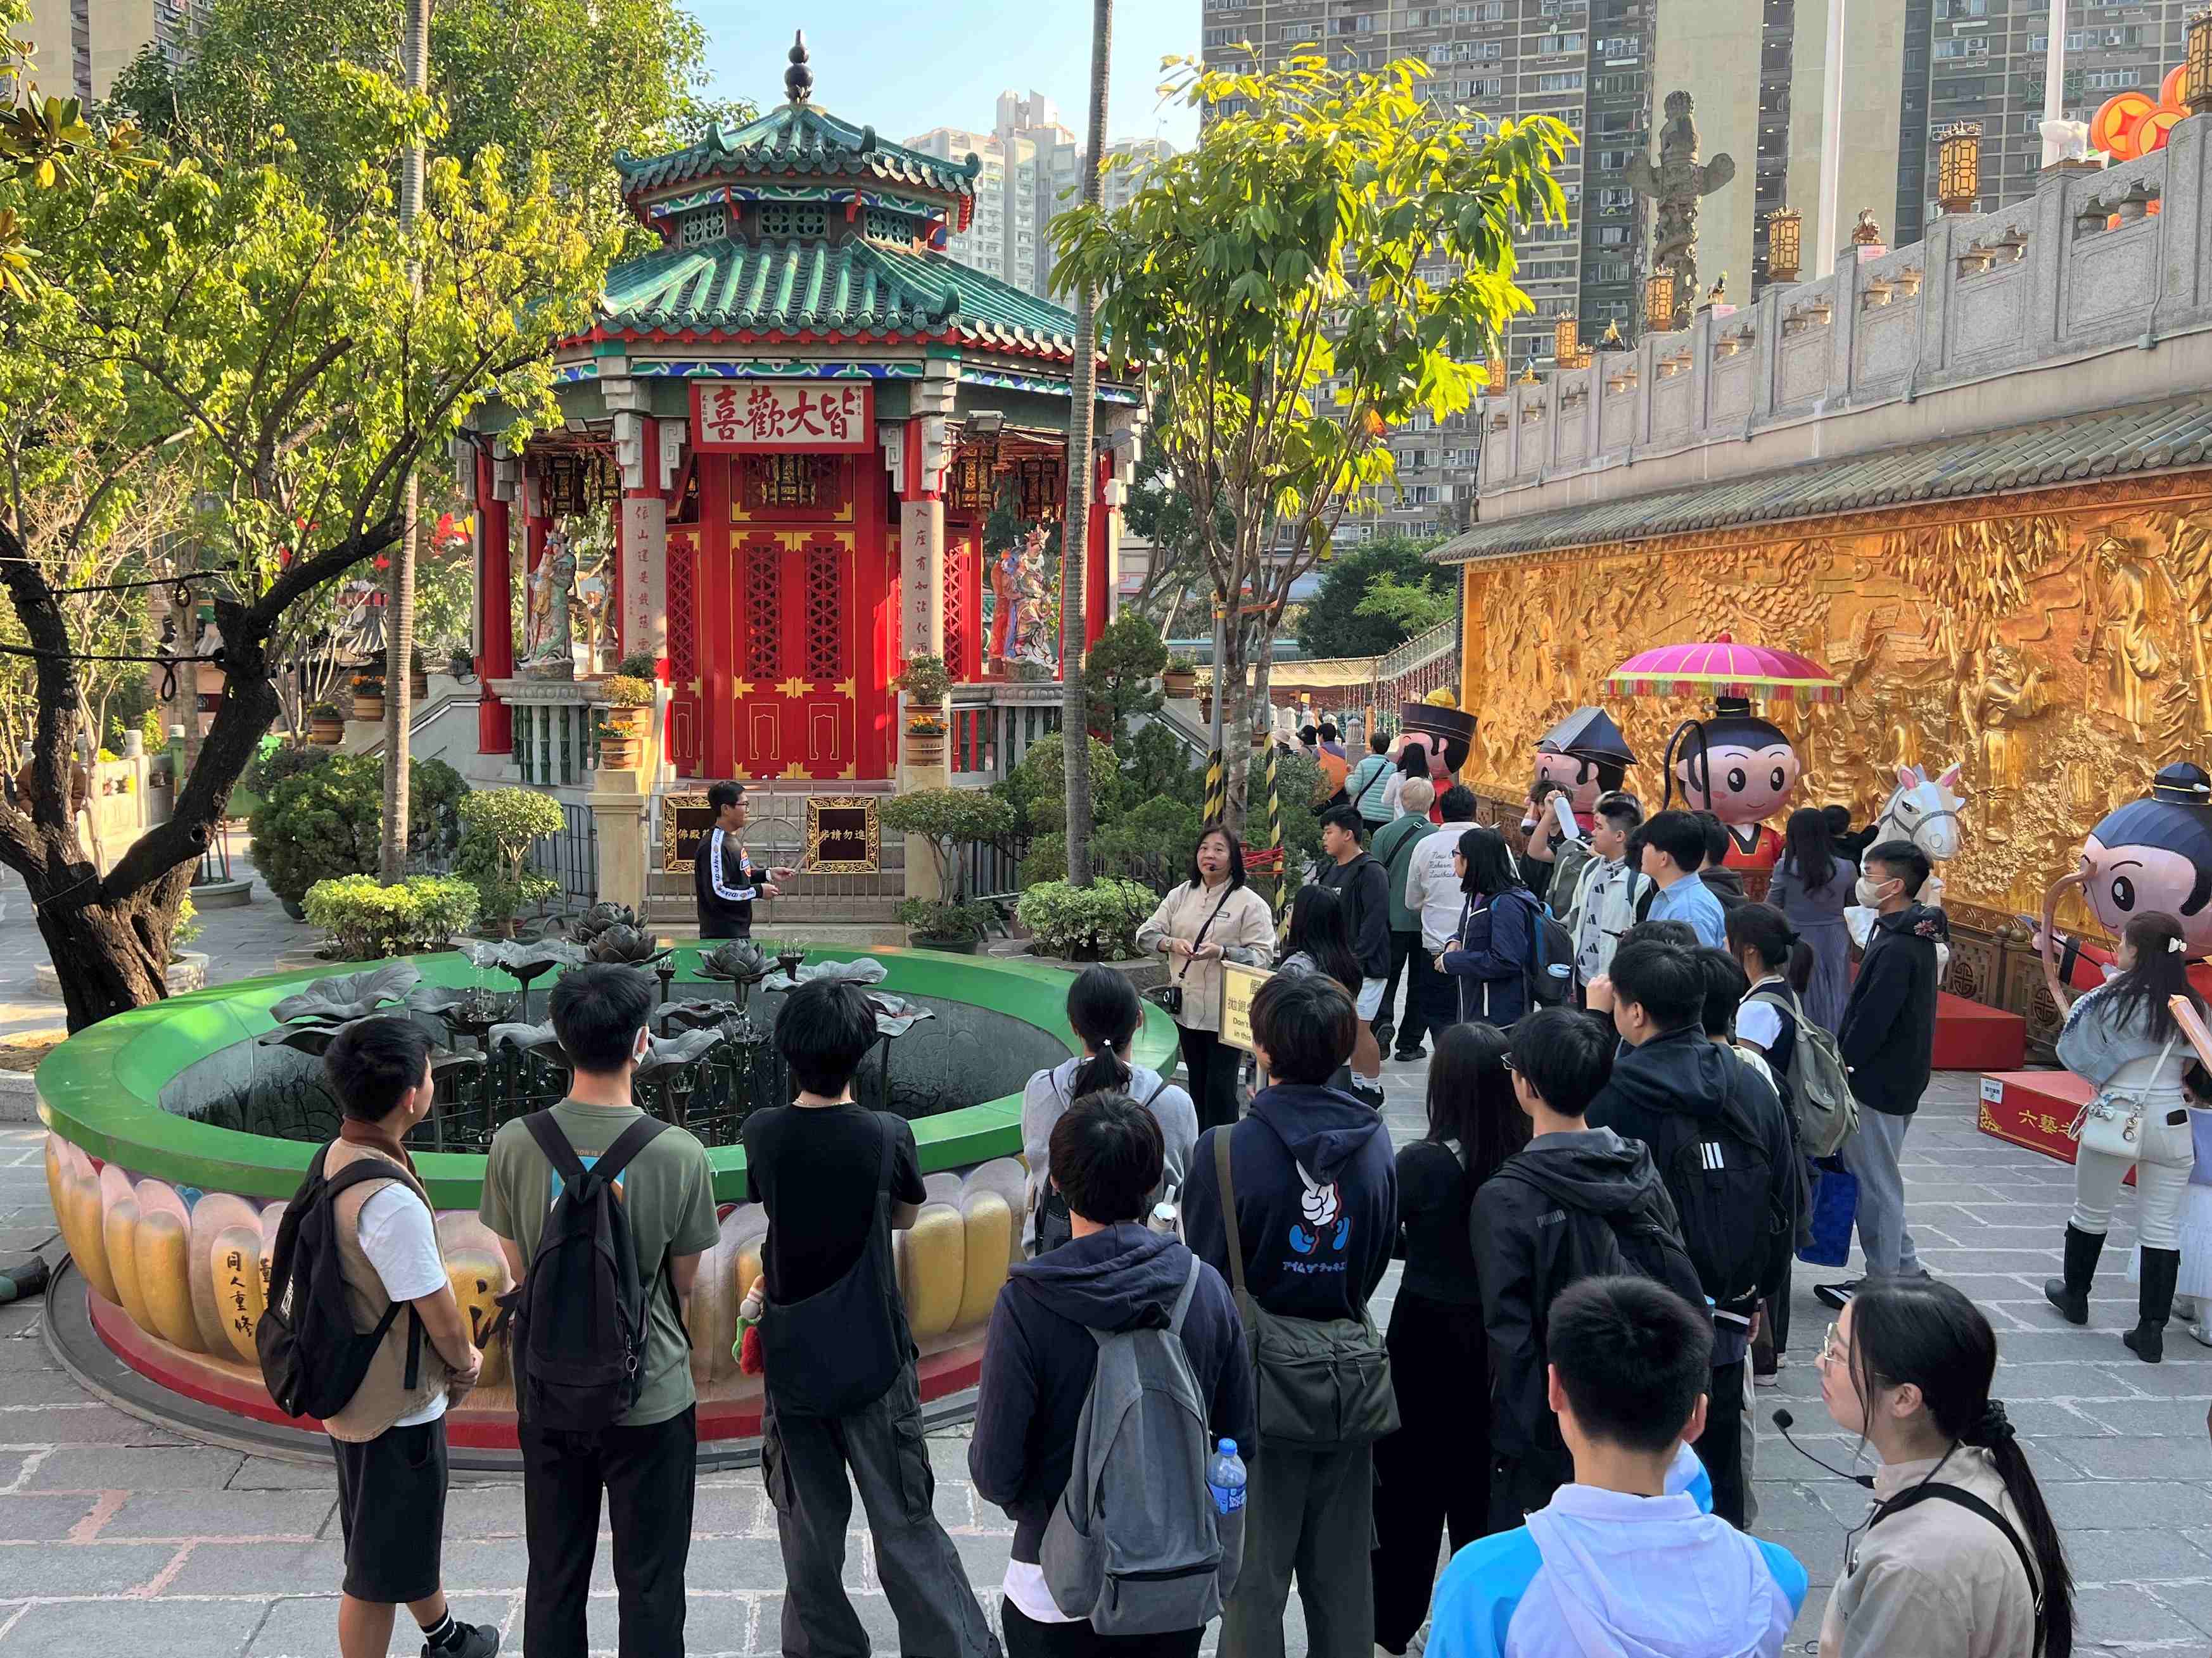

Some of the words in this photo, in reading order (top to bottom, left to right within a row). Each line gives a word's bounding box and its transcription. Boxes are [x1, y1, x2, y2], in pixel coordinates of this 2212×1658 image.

[819, 828, 866, 842] 非請勿進
[1233, 1016, 1249, 1029] Don't
[1242, 1032, 1252, 1042] this
